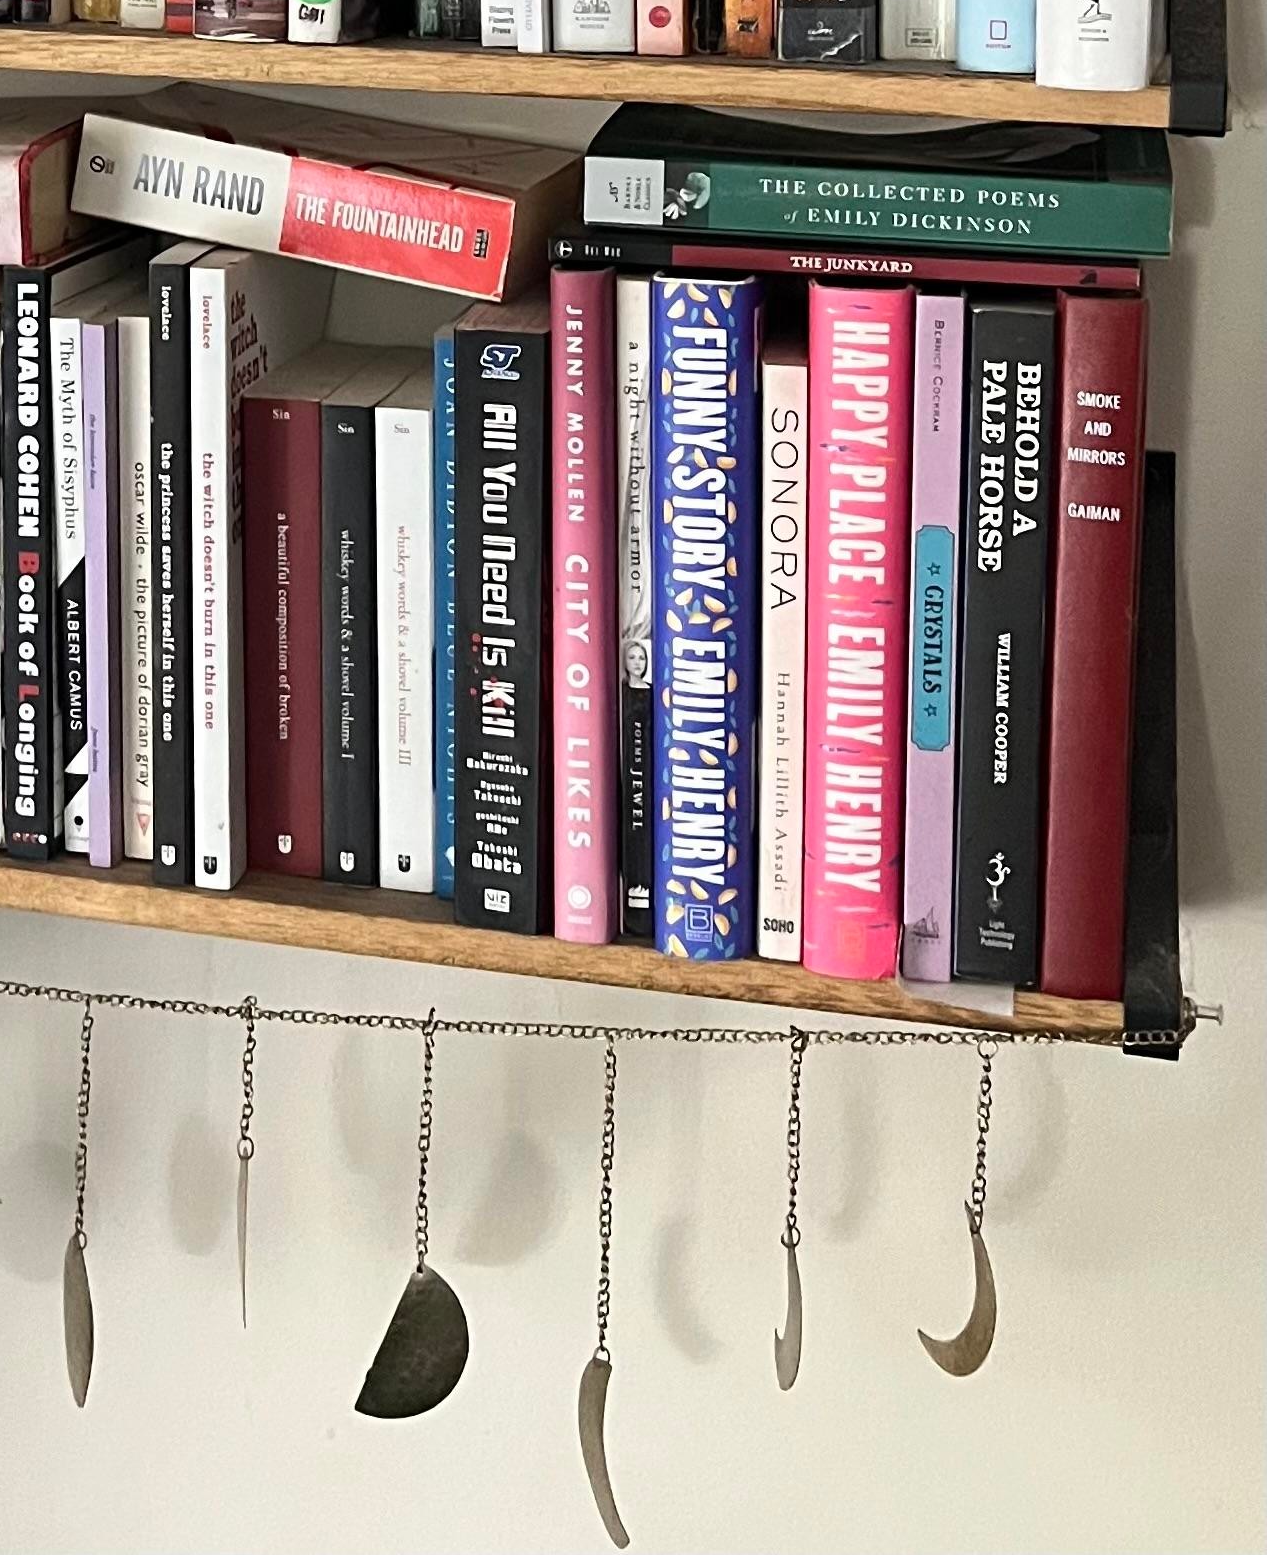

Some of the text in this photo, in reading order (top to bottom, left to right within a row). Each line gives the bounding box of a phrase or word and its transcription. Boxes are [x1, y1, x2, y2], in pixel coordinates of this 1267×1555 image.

[132, 153, 263, 217] AYN RAND
[759, 178, 1061, 209] THE COLLECTED POEMS
[161, 286, 171, 340] lovelace
[18, 283, 39, 536] LEONARD COHEN
[565, 304, 585, 522] JENNY MOLLEN
[828, 322, 891, 585] HAPPY PLACE
[977, 360, 1006, 572] PALE HORSE
[1012, 362, 1040, 536] BEHOLD A
[1067, 447, 1126, 467] MIRRORS
[1076, 391, 1122, 410] SMOKE
[1084, 421, 1112, 437] AND
[134, 463, 150, 554] oscar wilde
[769, 407, 799, 611] SONORA
[1068, 504, 1121, 523] GAIMAN
[66, 599, 83, 730] ALBERT CAMUS
[567, 554, 591, 849] CITY OF LIKES
[993, 632, 1011, 784] WILLIAM COOPER
[631, 768, 645, 830] JEWEL
[671, 637, 725, 886] EMILY HENRY
[826, 624, 884, 892] EMILY HENRY
[762, 917, 795, 934] SOHO
